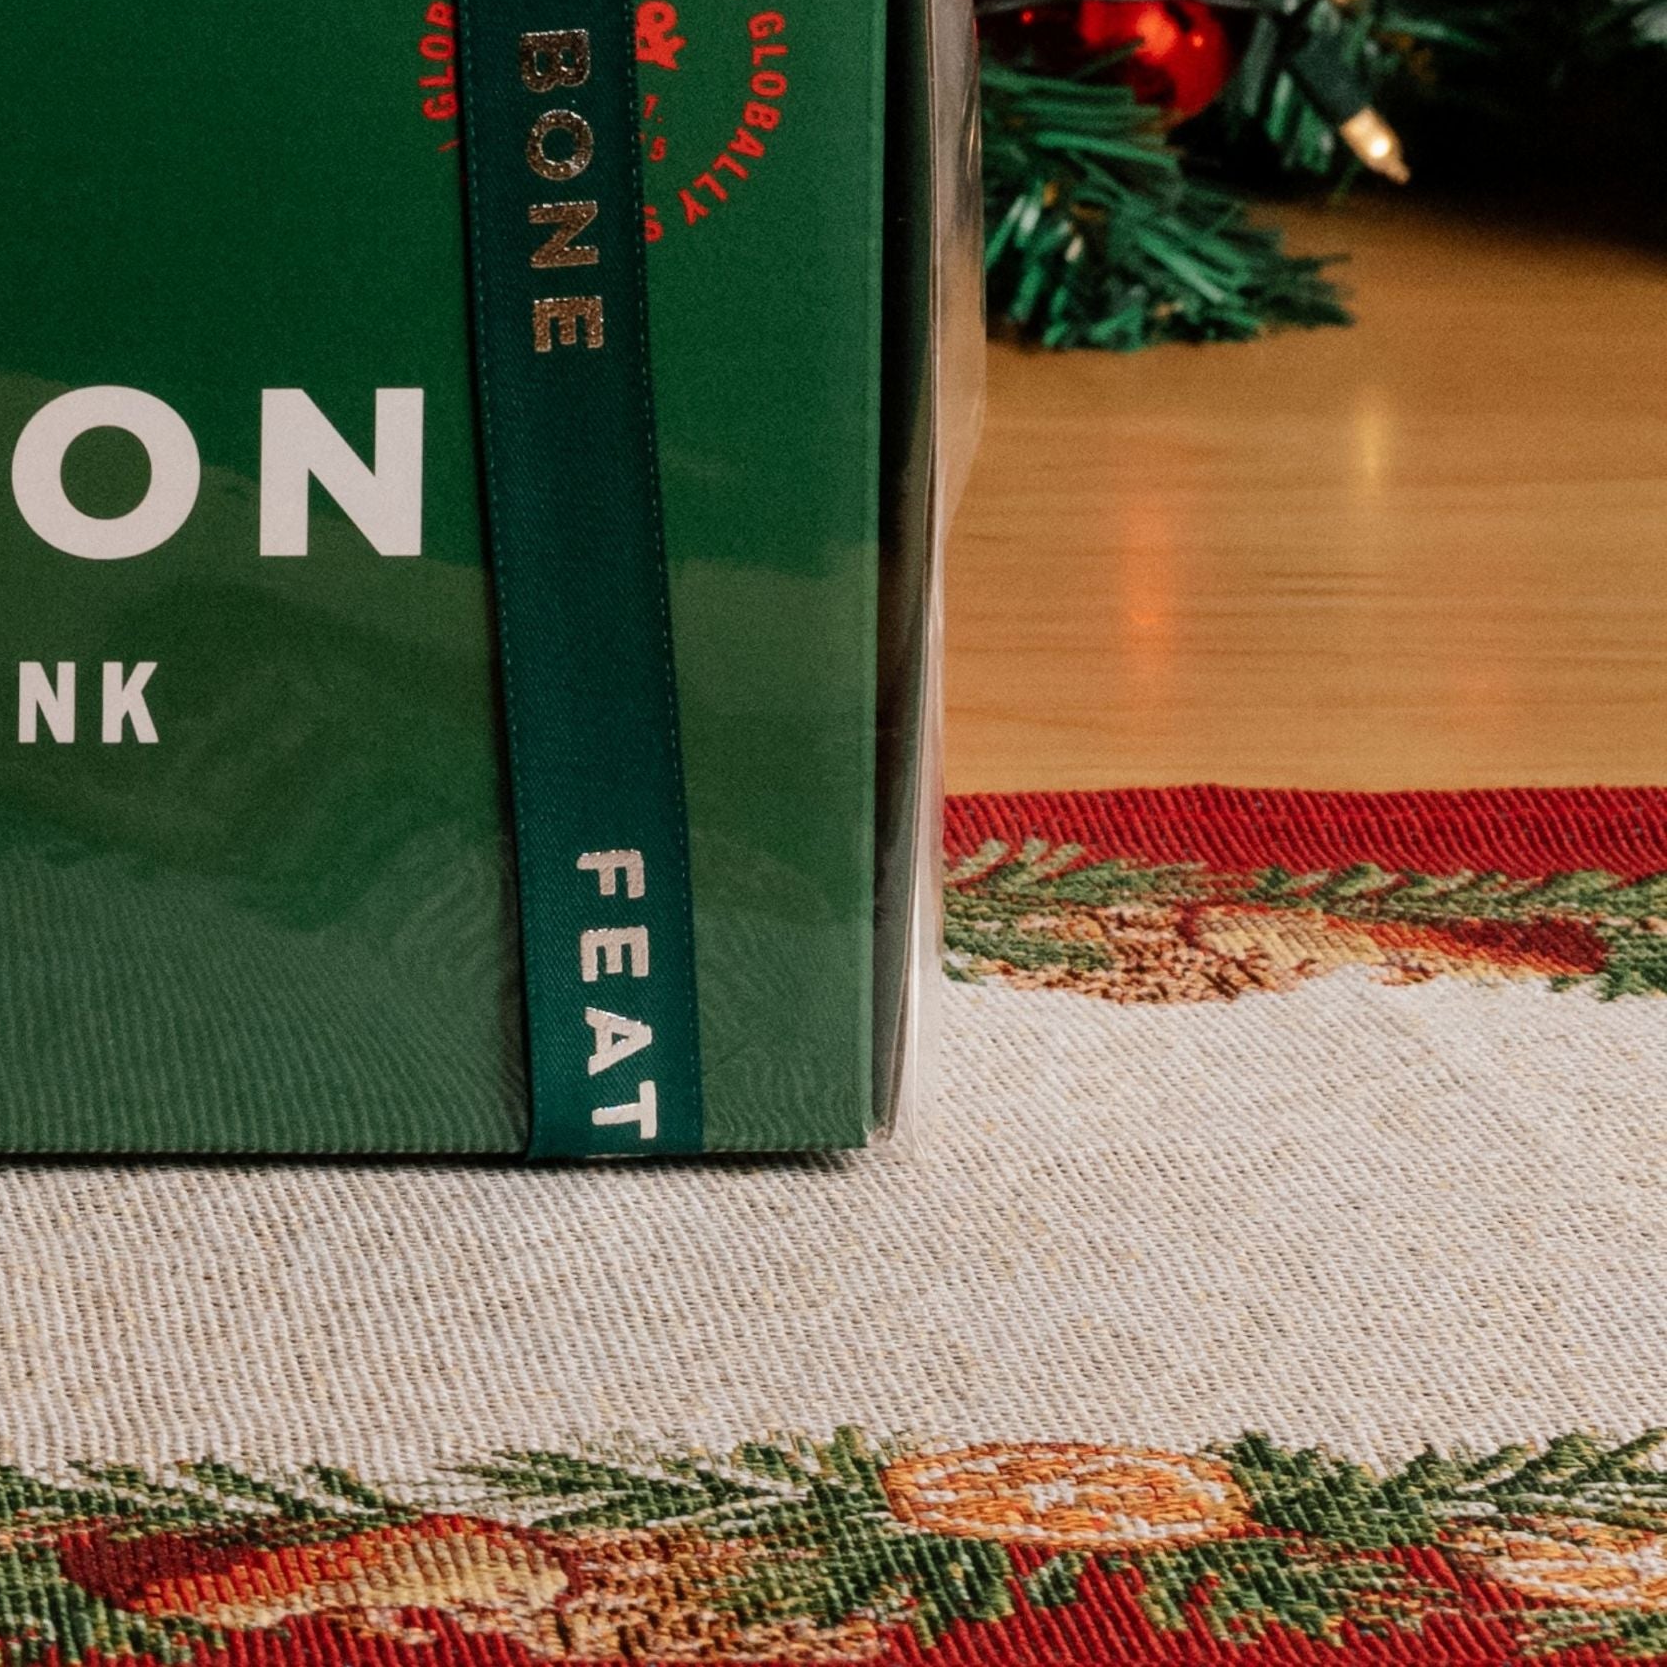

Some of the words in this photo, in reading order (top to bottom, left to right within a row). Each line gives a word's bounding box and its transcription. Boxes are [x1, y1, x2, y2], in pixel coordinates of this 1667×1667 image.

[517, 27, 605, 354] BONE
[677, 10, 790, 227] GLOBALLY
[576, 848, 658, 1140] FEAT
